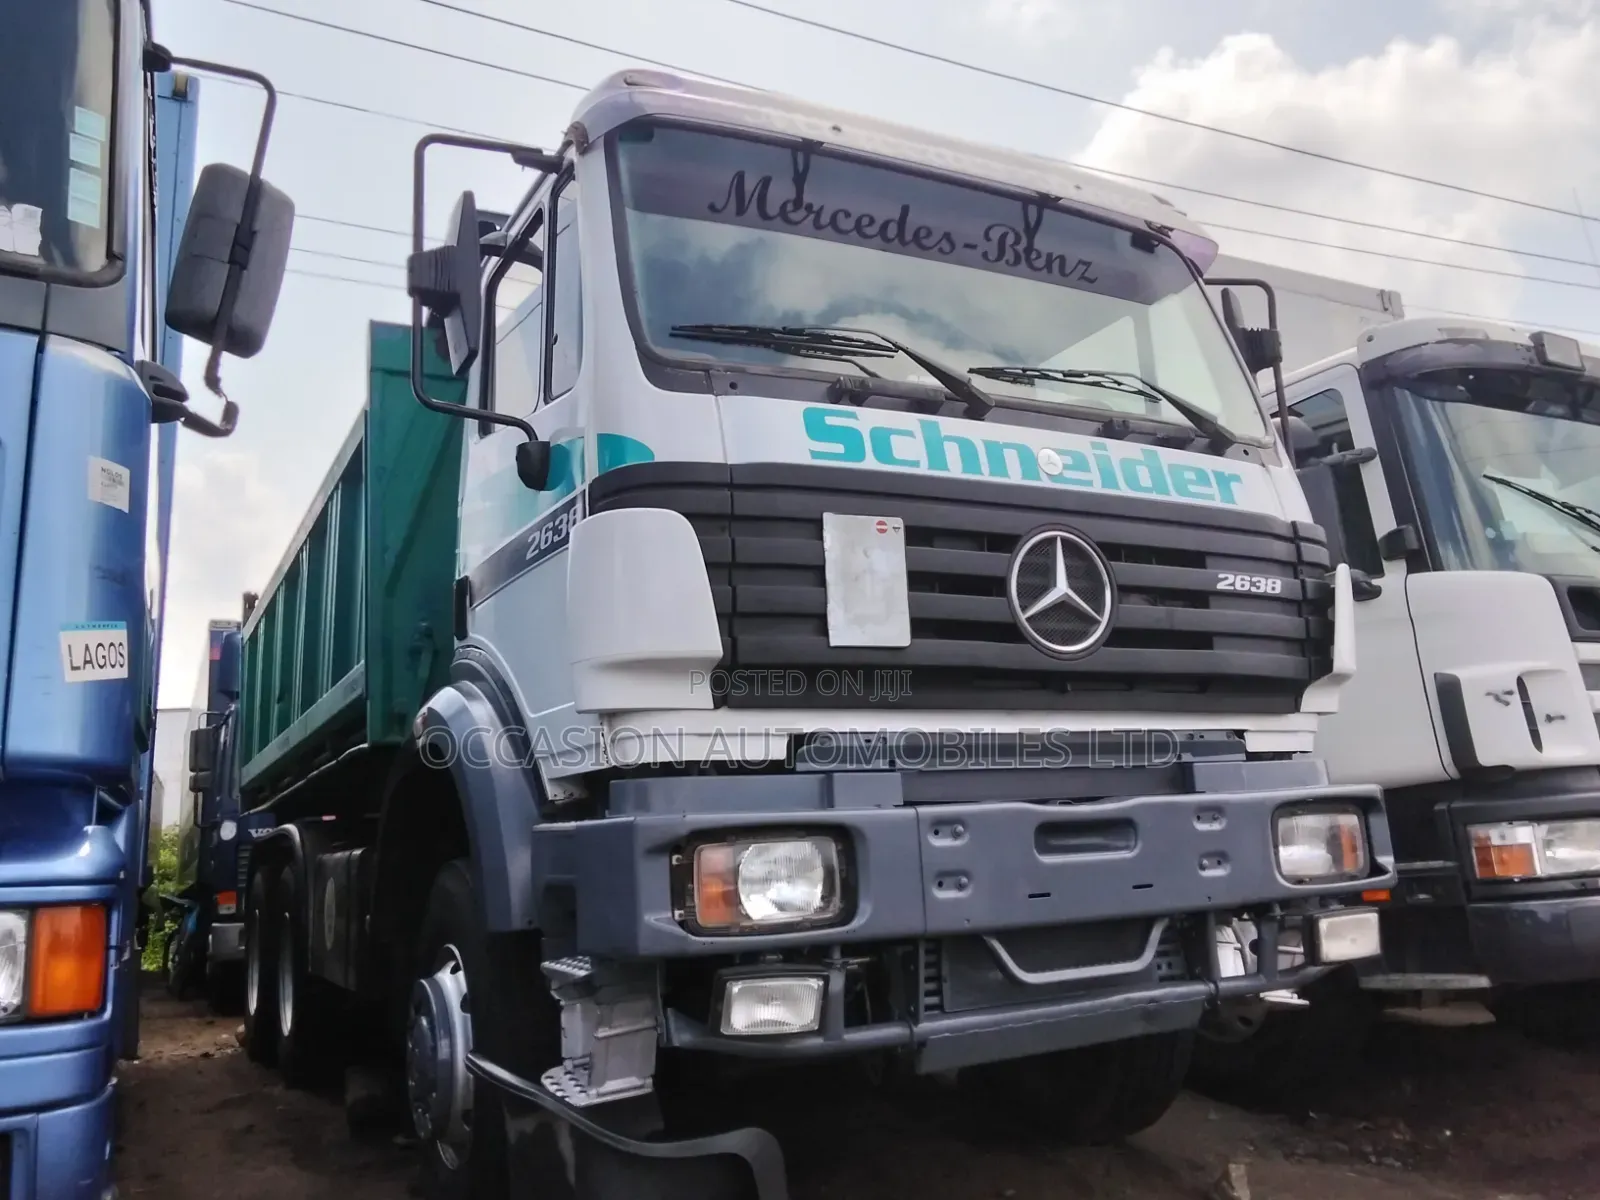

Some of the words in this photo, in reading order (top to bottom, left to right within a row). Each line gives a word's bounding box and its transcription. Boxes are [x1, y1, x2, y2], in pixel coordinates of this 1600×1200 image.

[707, 169, 1099, 285] Mercedes-Benz
[802, 406, 1243, 506] Schneider
[1216, 573, 1282, 594] 2638
[67, 641, 126, 672] LAGOS
